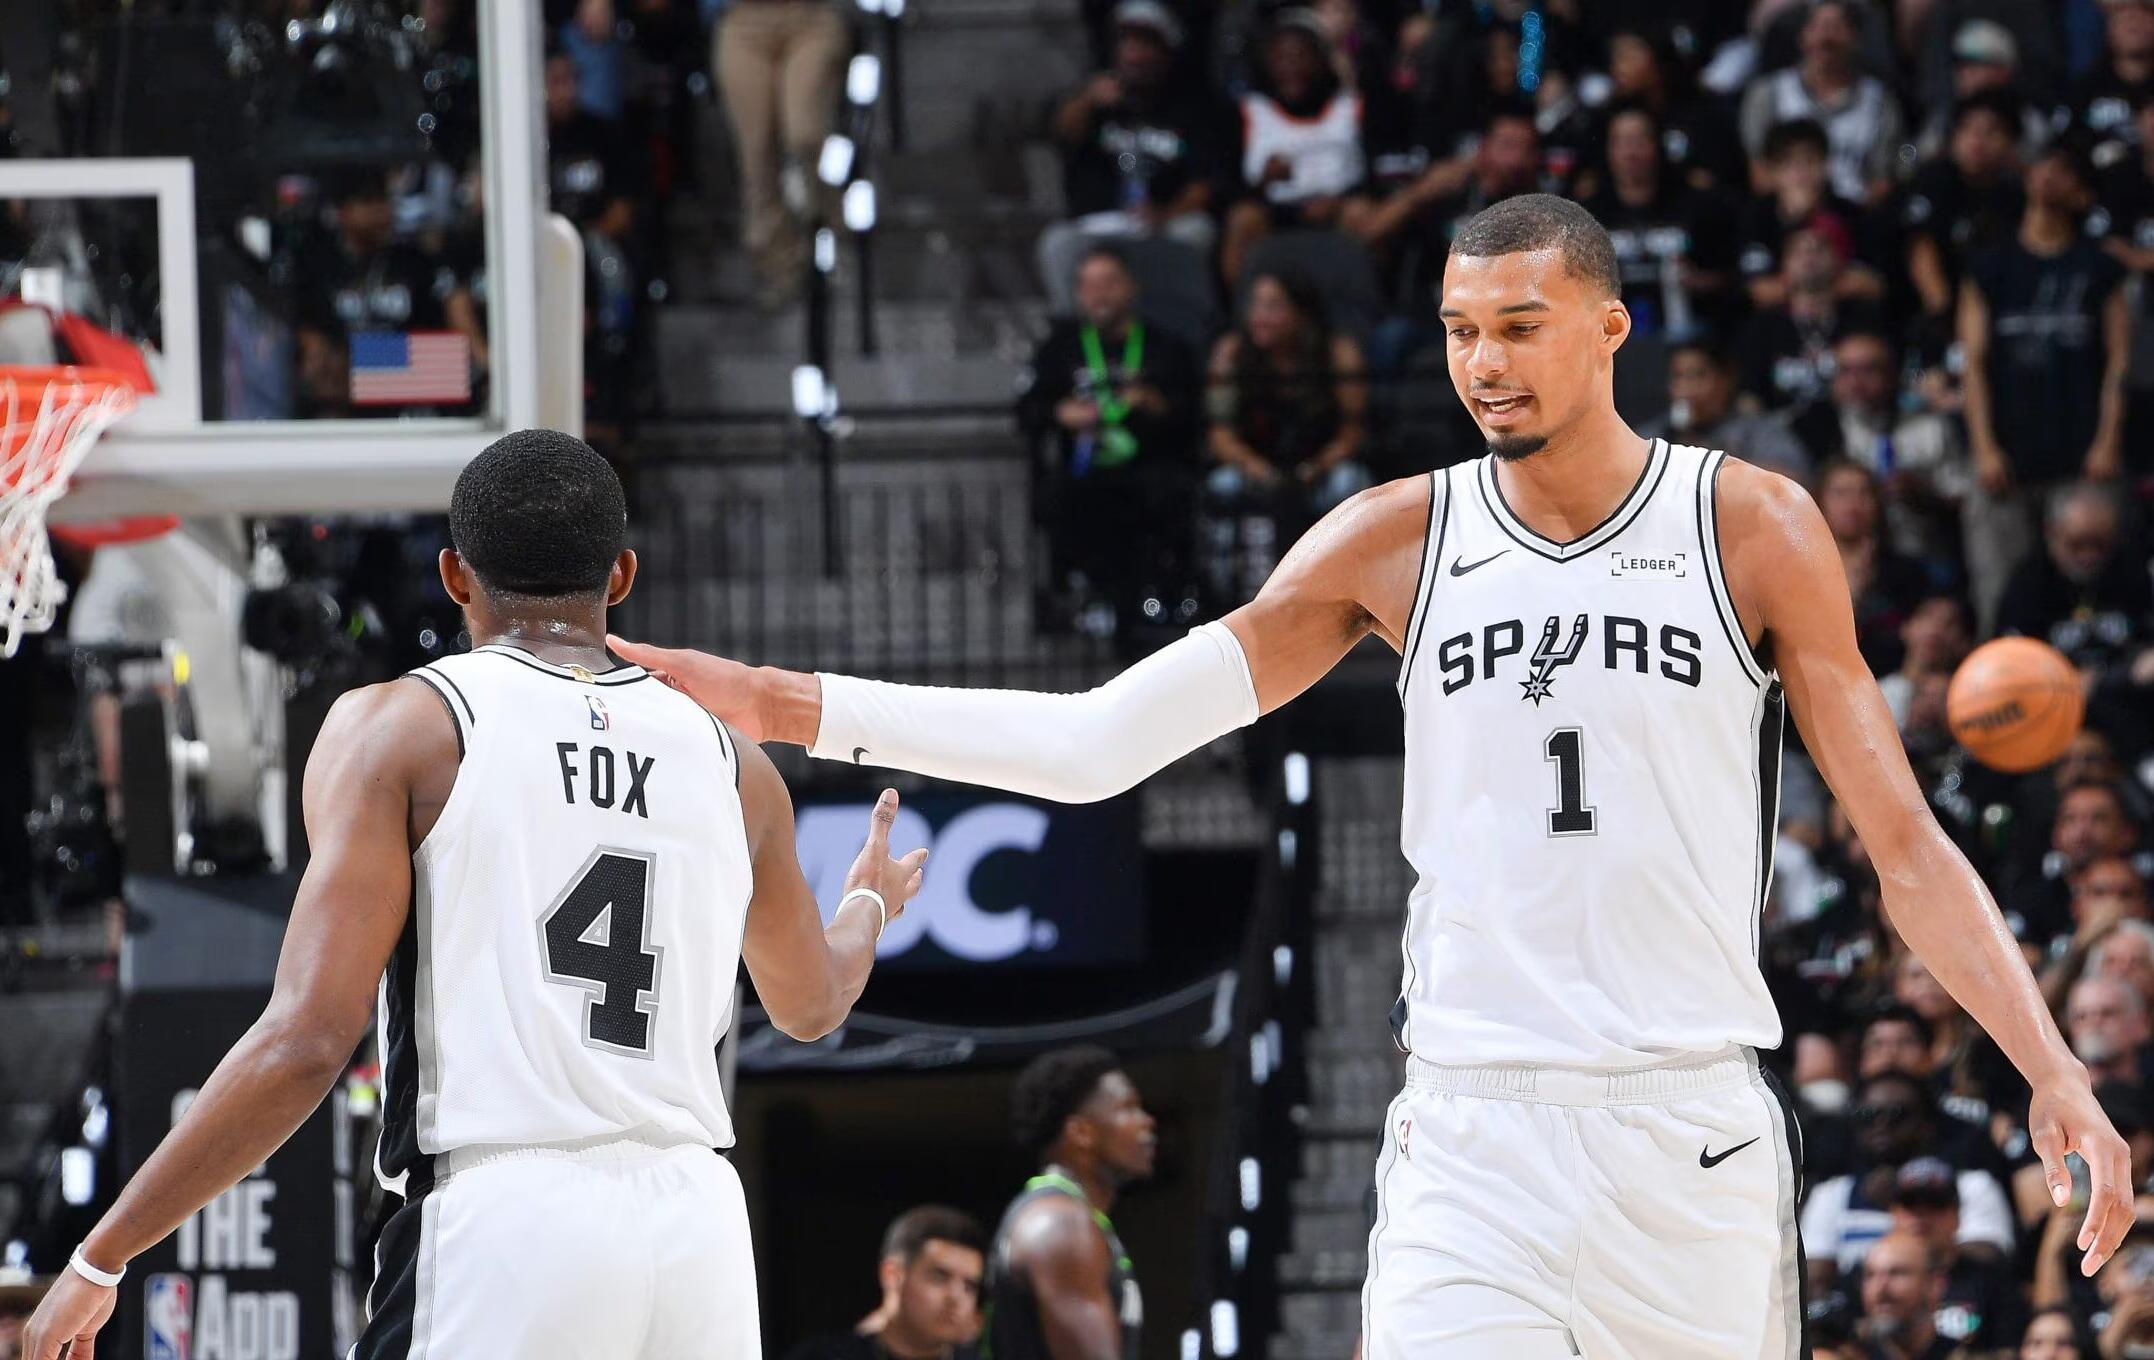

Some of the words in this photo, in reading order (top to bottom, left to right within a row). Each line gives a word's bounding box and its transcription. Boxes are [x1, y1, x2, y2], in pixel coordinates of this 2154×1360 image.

[1621, 558, 1676, 571] LEDGER
[1438, 613, 1702, 707] SPURS
[556, 742, 655, 819] FOX
[1543, 725, 1598, 838] 1
[535, 844, 665, 1062] 4
